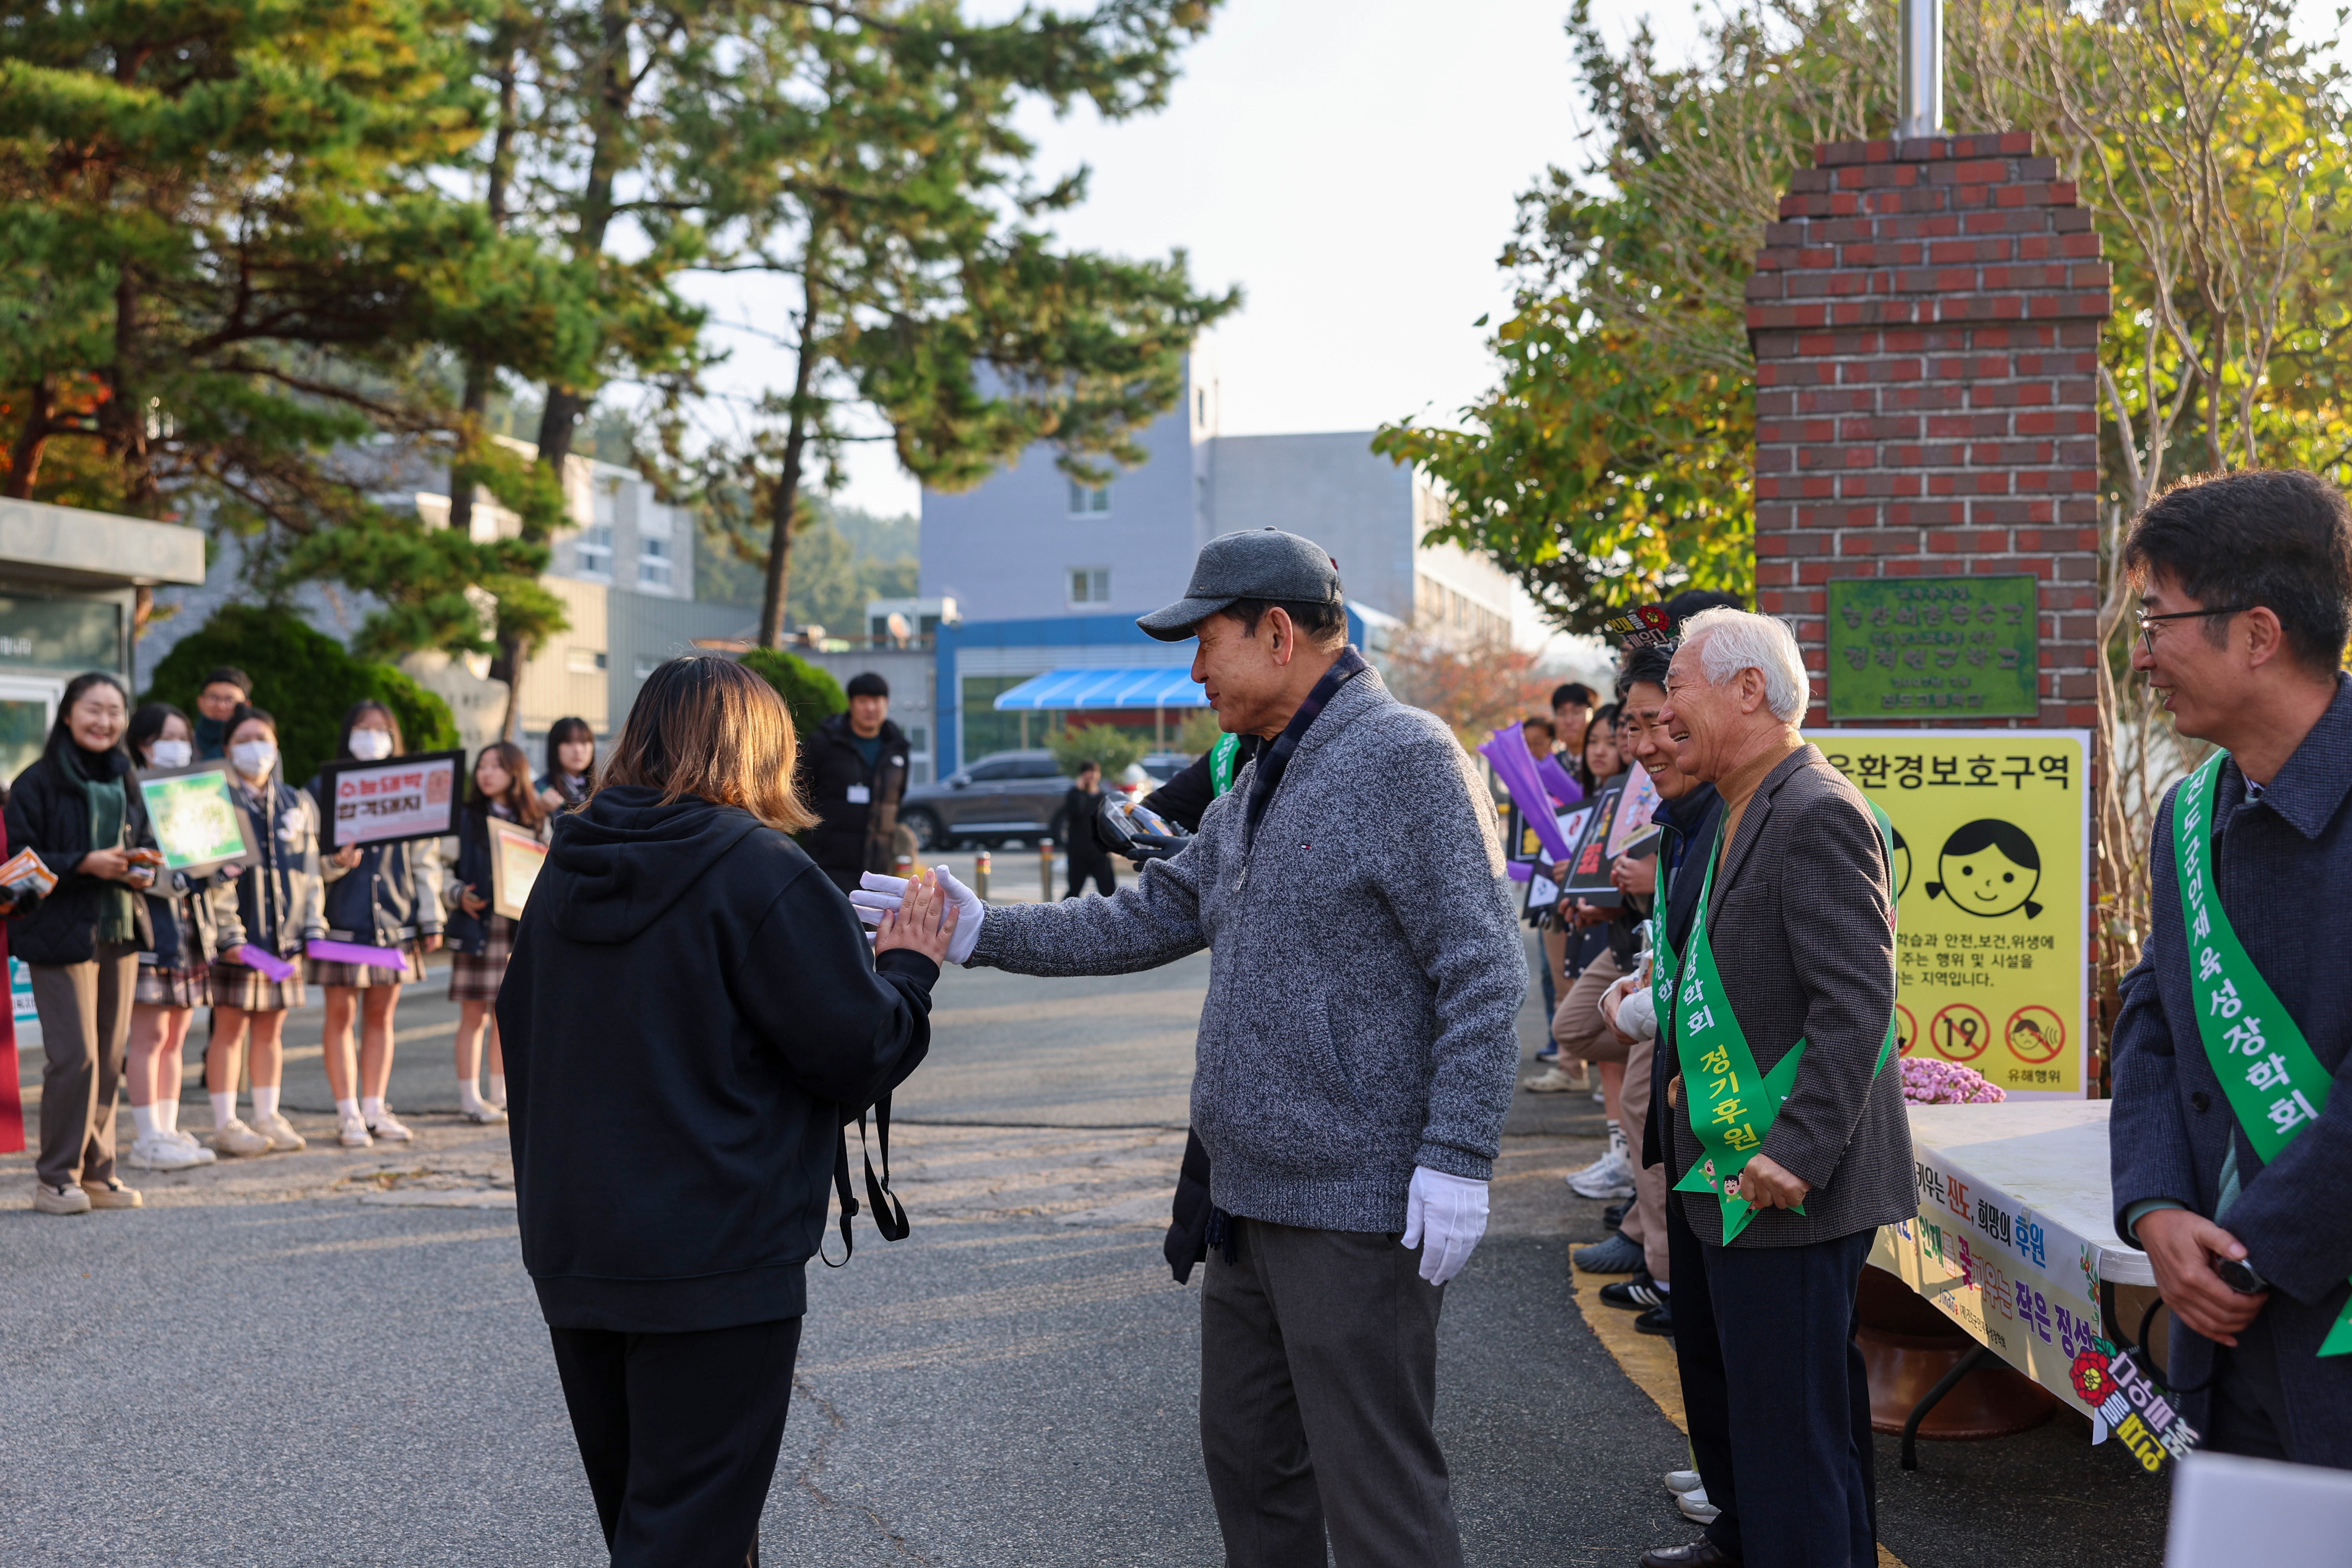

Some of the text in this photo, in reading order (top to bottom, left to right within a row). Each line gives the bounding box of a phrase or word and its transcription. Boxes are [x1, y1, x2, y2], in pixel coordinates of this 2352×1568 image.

[1606, 613, 1646, 634] 인재를
[1619, 627, 1669, 648] 피우다
[1901, 953, 2033, 969] 주는 행위 및 시설을
[1921, 971, 1995, 987] 지역입니다.
[1943, 1018, 1978, 1047] 19
[2007, 1068, 2061, 1083] 유해행위
[1700, 1044, 1760, 1151] 정기후원
[1978, 1198, 2012, 1247] 희망의
[2014, 1214, 2046, 1269] 후원
[1918, 1214, 1957, 1279] 인재를
[1958, 1234, 2013, 1320] 꽃피우는
[2015, 1279, 2053, 1346] 작은
[1938, 1287, 1955, 1313] Jindo
[2107, 1351, 2200, 1461] 꽃피우다
[2100, 1390, 2167, 1472] 인재를
